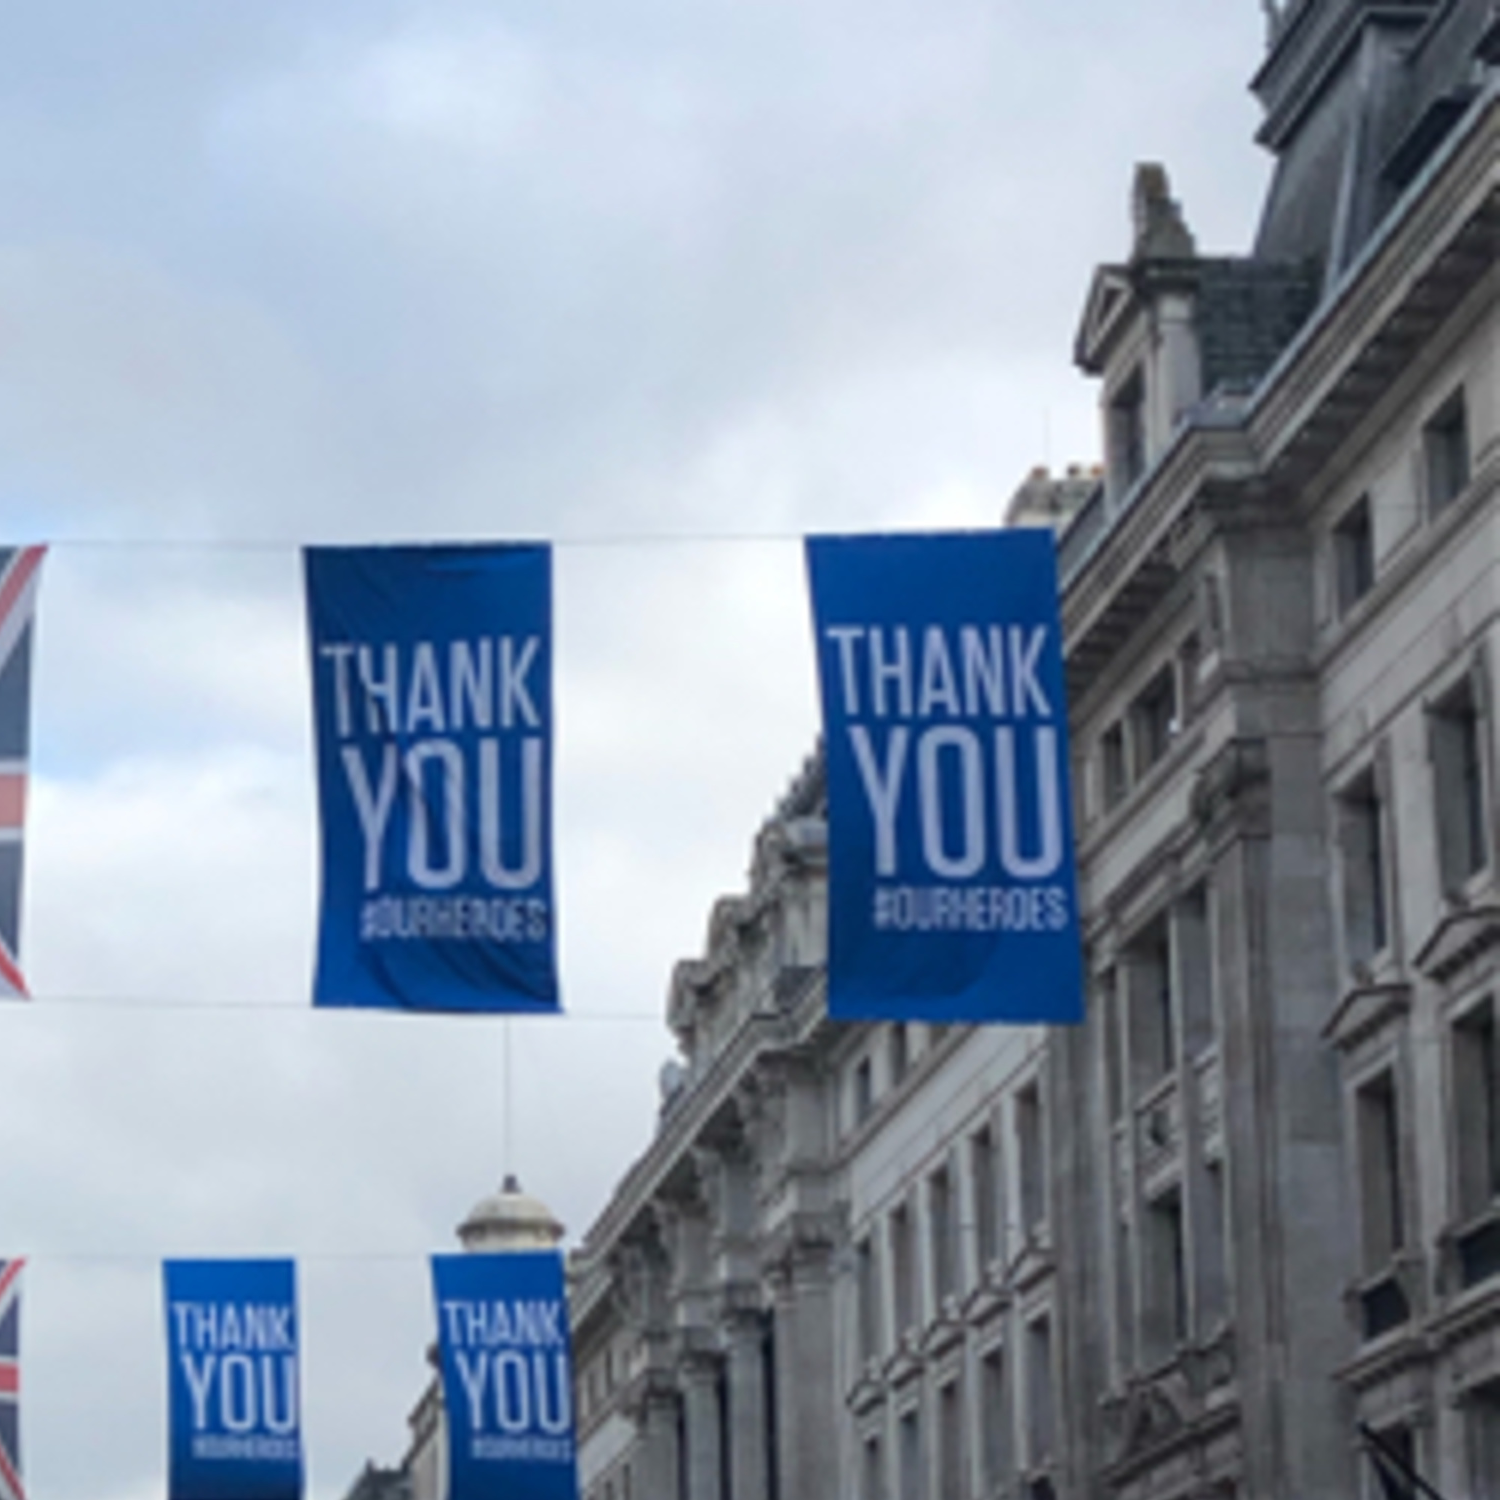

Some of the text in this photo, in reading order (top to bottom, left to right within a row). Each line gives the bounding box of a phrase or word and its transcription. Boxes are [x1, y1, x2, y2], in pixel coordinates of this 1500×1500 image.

[320, 636, 540, 737] THANK
[826, 626, 1050, 717] THANK
[341, 736, 542, 890] YOU
[849, 725, 1062, 878] YOU
[362, 896, 546, 941] #OURHEROES
[874, 886, 1067, 931] #OURHEROES
[171, 1302, 293, 1352] THANK
[443, 1300, 563, 1346] THANK
[180, 1353, 297, 1434] YOU
[454, 1349, 570, 1434] YOU
